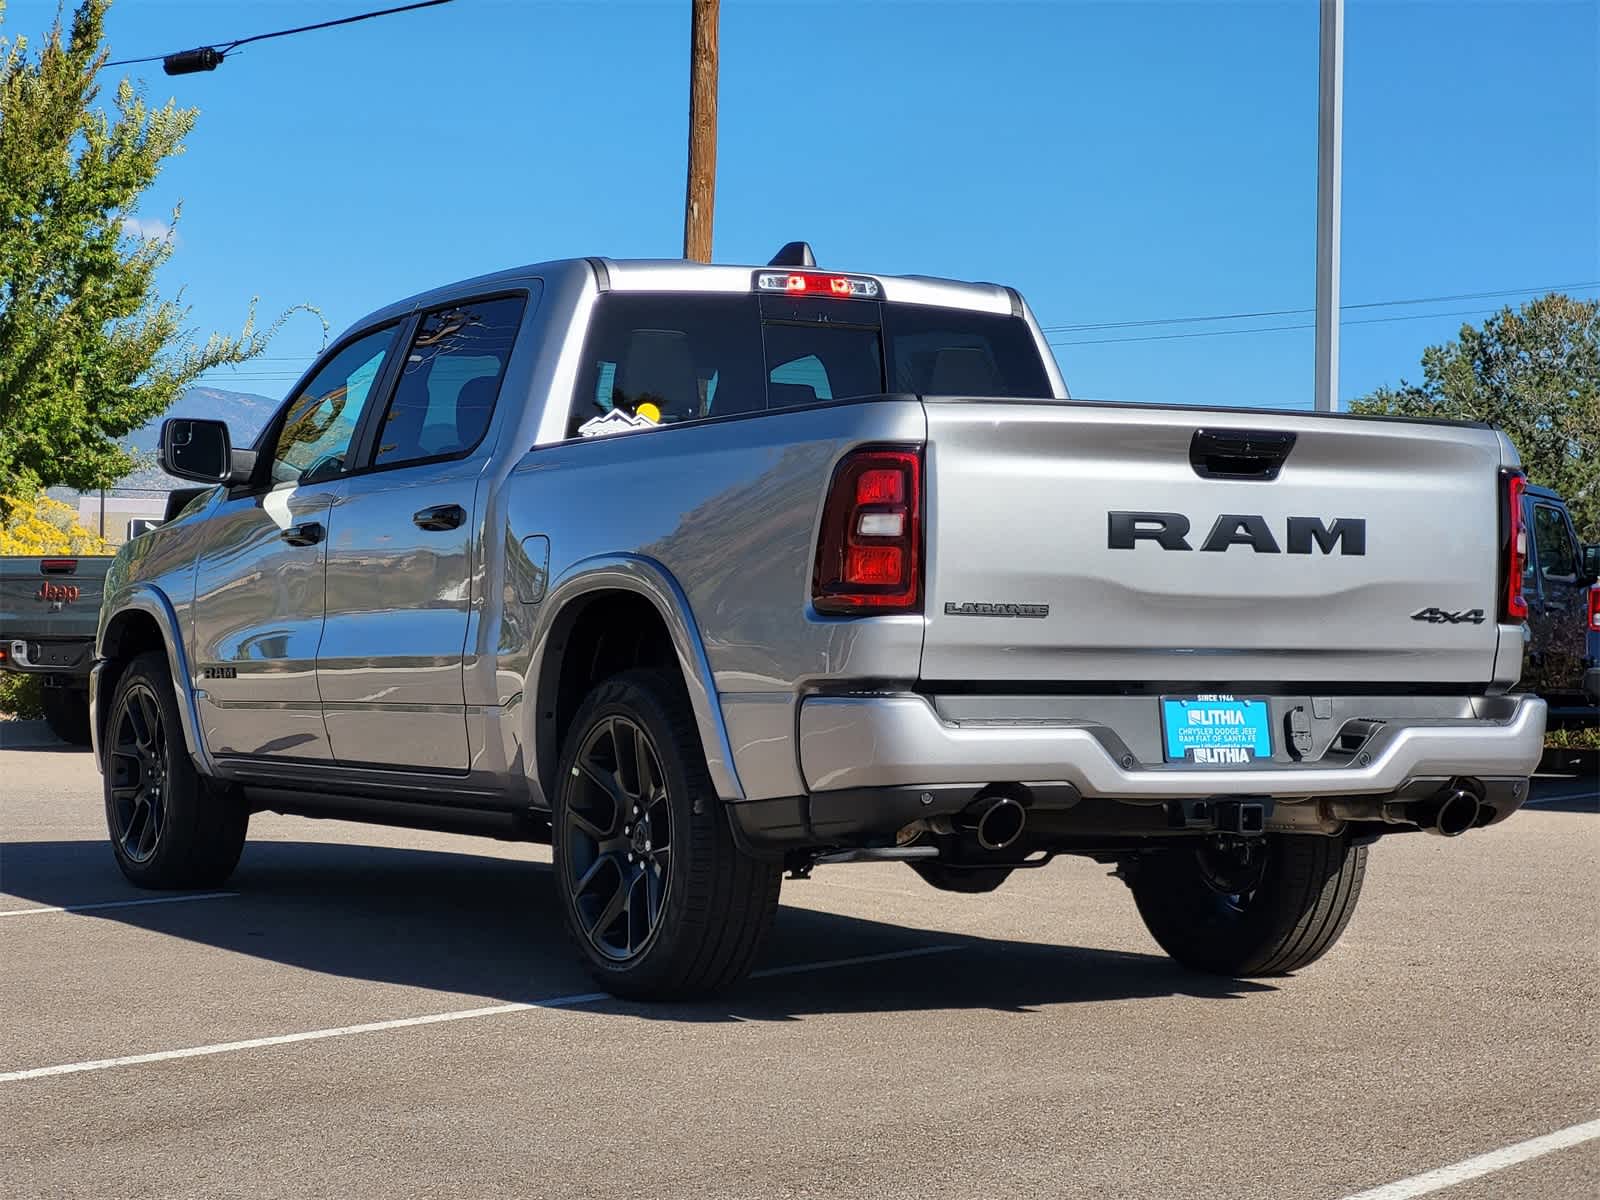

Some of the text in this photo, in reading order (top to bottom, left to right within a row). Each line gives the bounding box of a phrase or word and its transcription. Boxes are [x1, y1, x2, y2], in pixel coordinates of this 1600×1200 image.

[1107, 510, 1366, 556] RAM
[38, 580, 80, 604] Jeep
[1410, 607, 1486, 624] 4x4
[203, 667, 238, 679] RAM
[1197, 694, 1218, 702] SINCE
[1200, 709, 1245, 725] LITHIA
[1178, 727, 1257, 735] CHRYSLER DODGE JEEP
[1178, 735, 1257, 743] RAM FIAT OF SANTA FE
[1206, 748, 1250, 763] LITHIA
